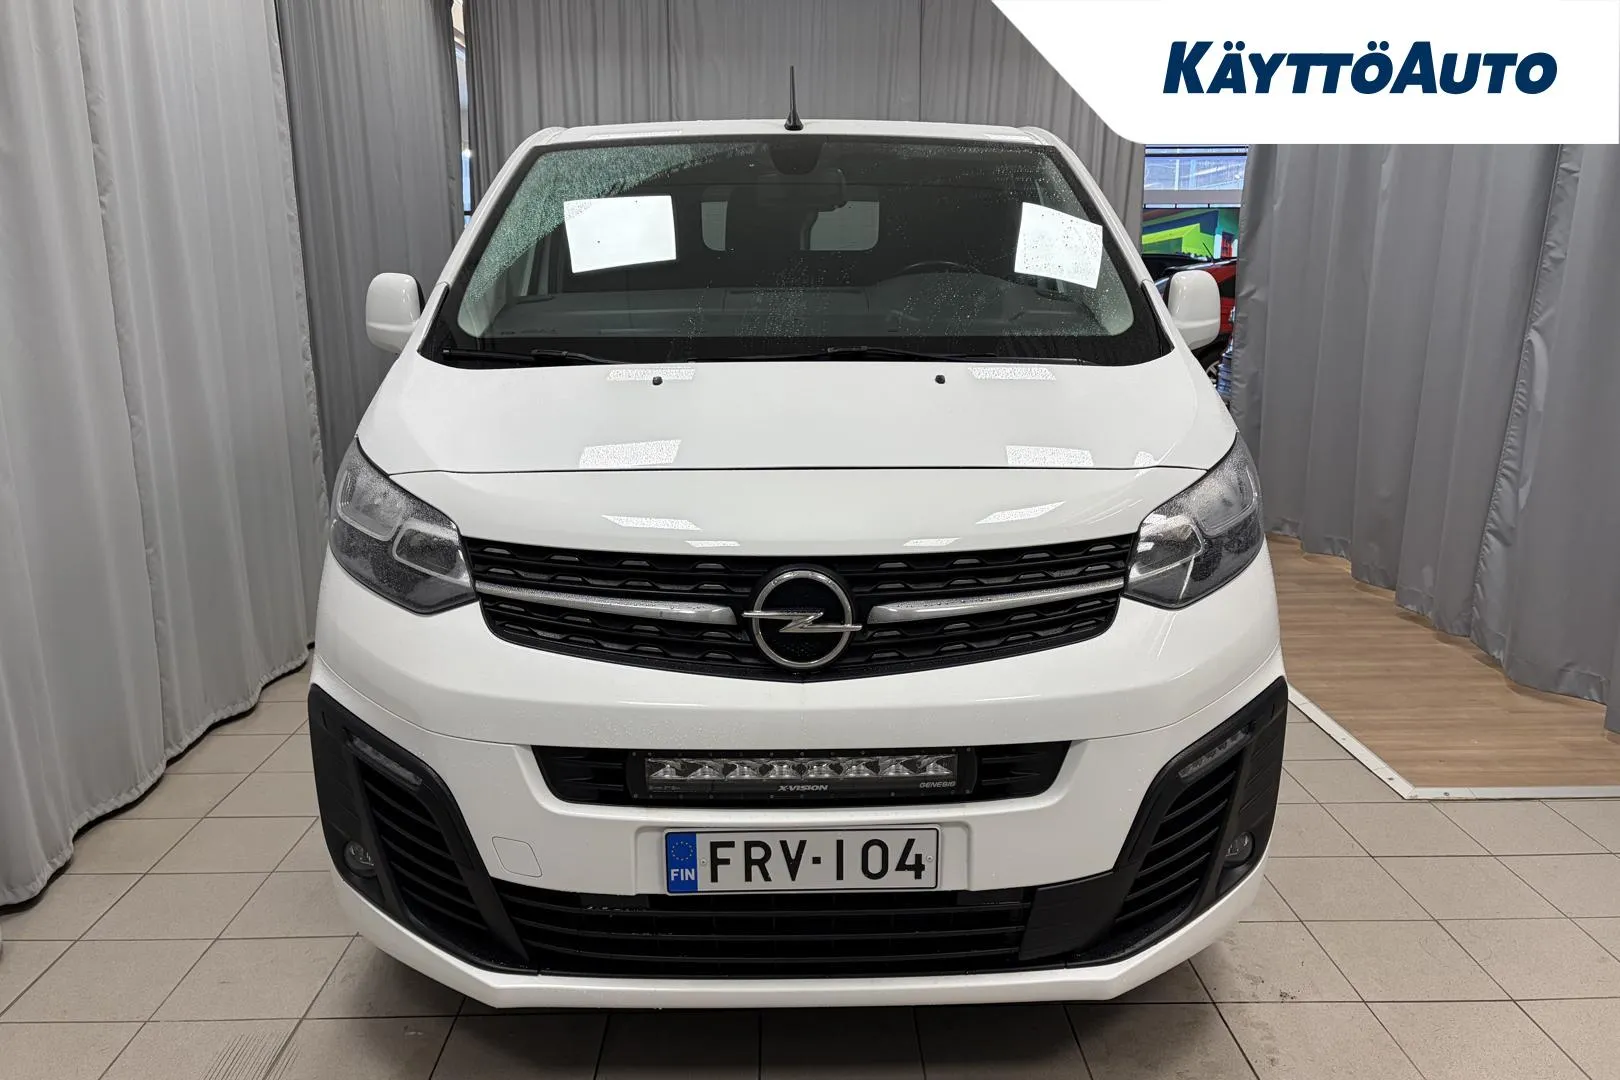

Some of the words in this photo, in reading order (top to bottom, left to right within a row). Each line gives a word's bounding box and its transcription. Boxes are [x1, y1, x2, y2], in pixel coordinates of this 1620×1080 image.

[776, 784, 829, 792] X-VISION
[709, 838, 926, 884] FRV-104
[670, 868, 696, 882] FIN
